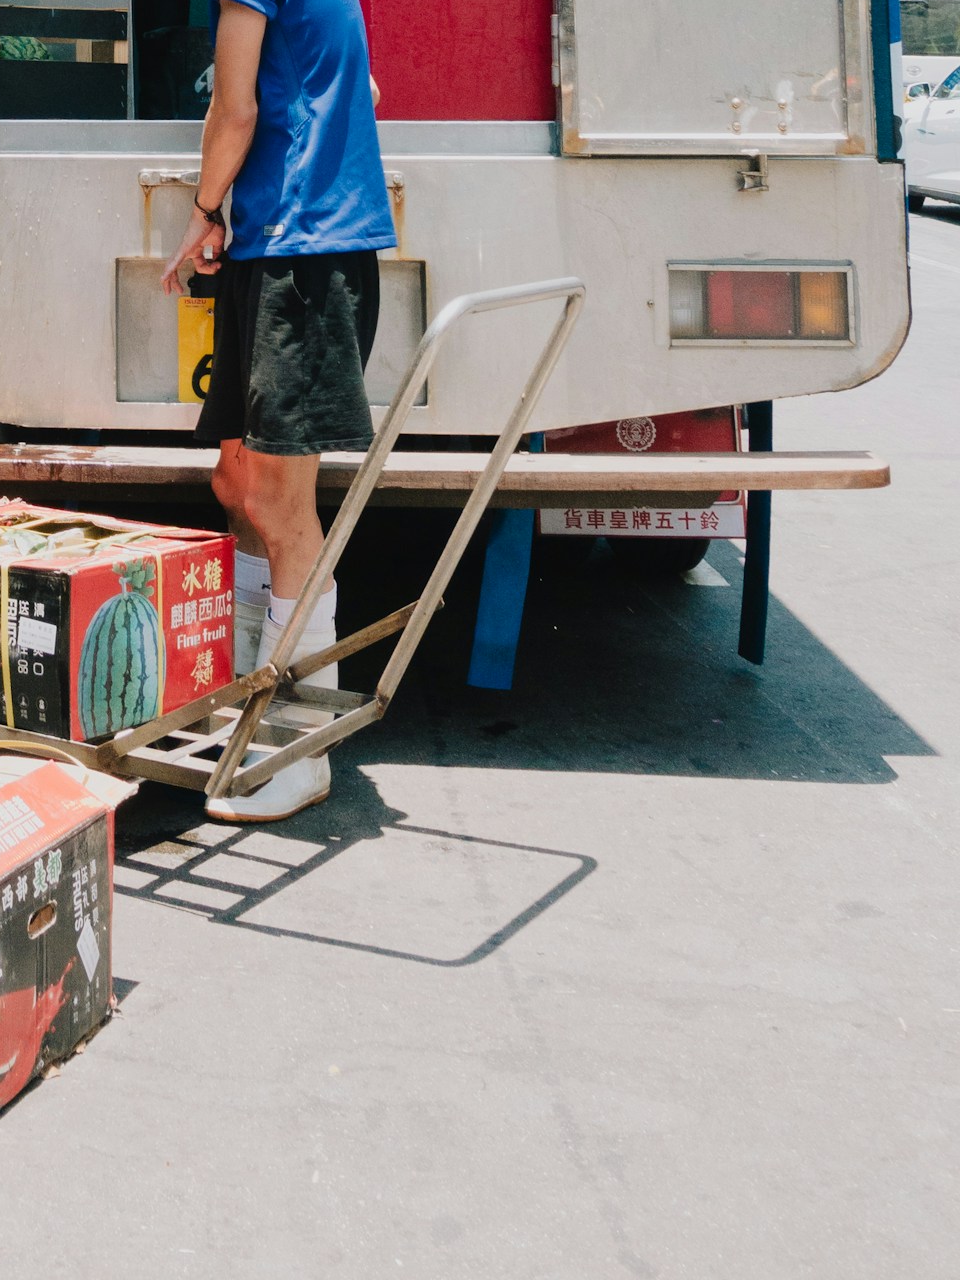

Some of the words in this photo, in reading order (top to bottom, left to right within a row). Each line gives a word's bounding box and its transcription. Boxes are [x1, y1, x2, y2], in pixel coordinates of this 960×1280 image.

[563, 509, 719, 531] 貨車皇牌五十鈴
[181, 558, 223, 597] 冰糖
[171, 593, 227, 629] 麒麟西瓜
[177, 633, 201, 650] Fine
[202, 625, 226, 643] fruit
[72, 869, 84, 932] FRUITS
